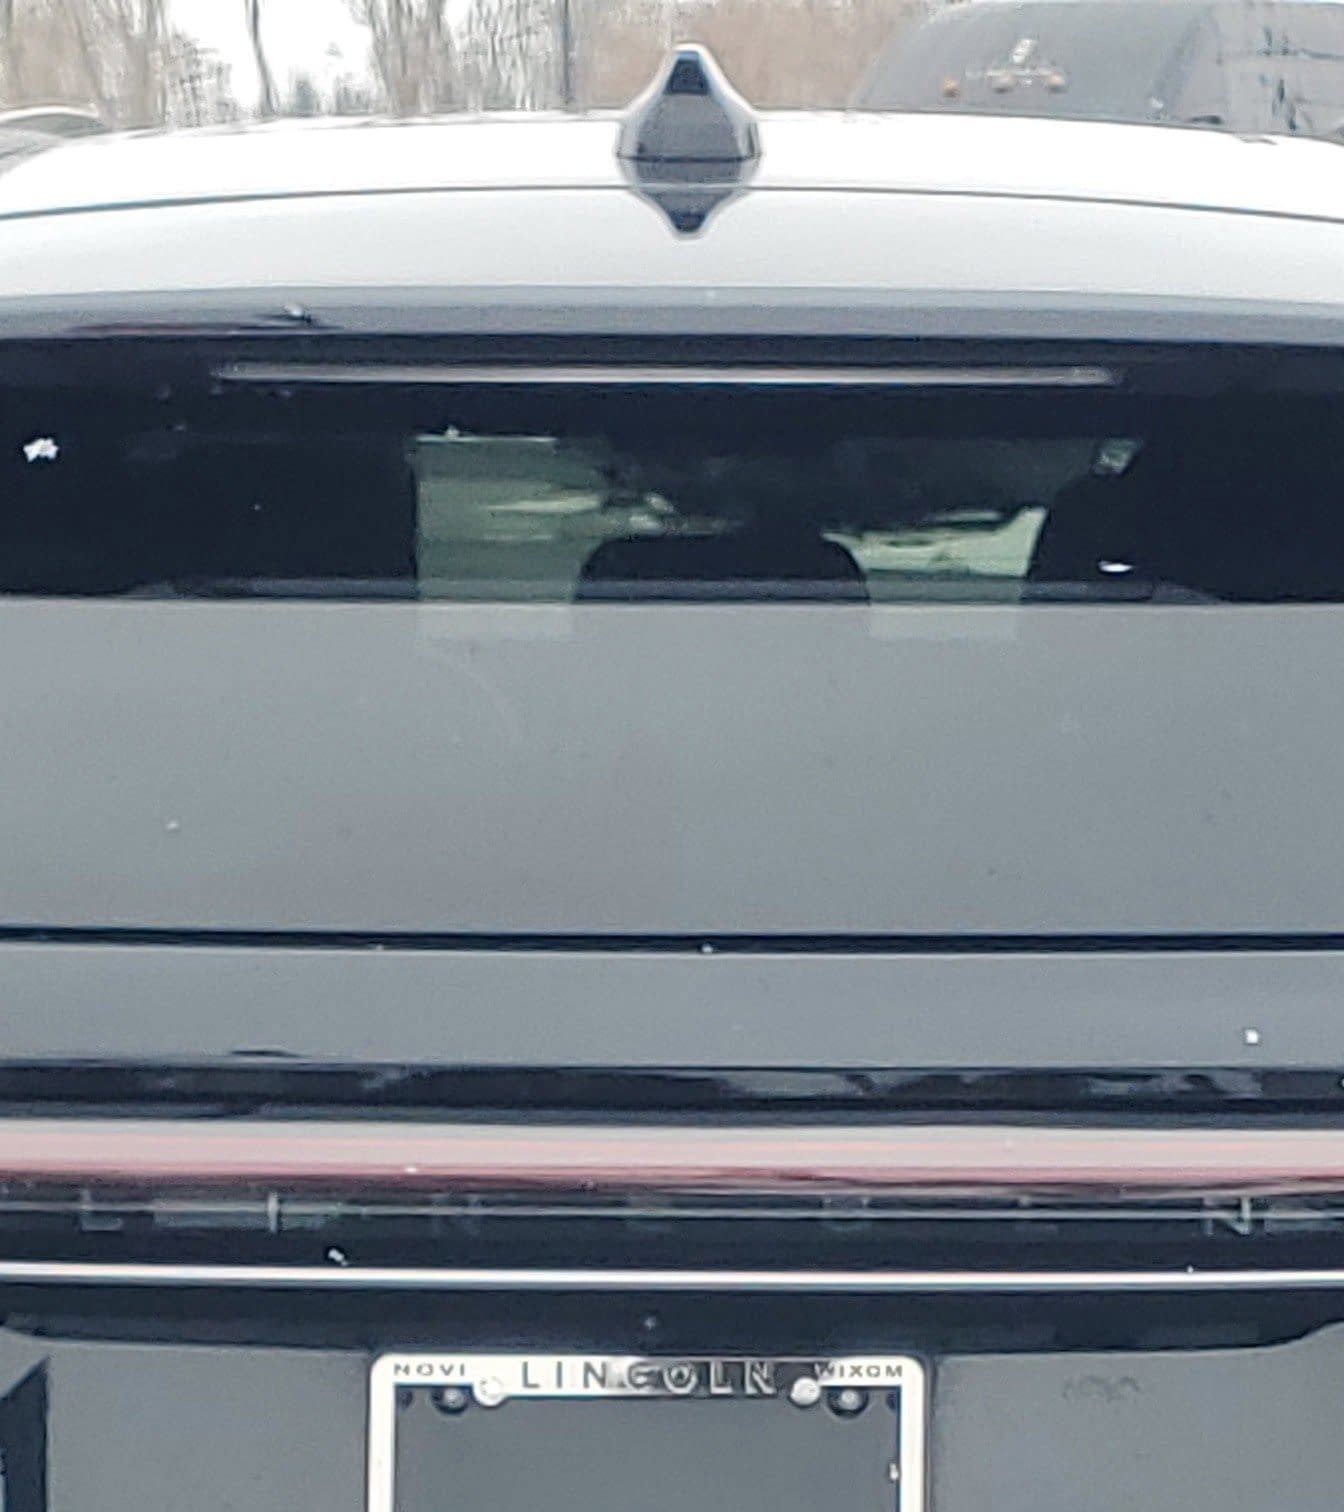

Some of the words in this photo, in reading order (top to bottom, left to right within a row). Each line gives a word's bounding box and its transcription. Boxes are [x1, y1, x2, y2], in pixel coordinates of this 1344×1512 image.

[393, 1363, 466, 1377] NOVI
[521, 1360, 777, 1394] LINCOLN
[815, 1362, 904, 1378] WIXOM
